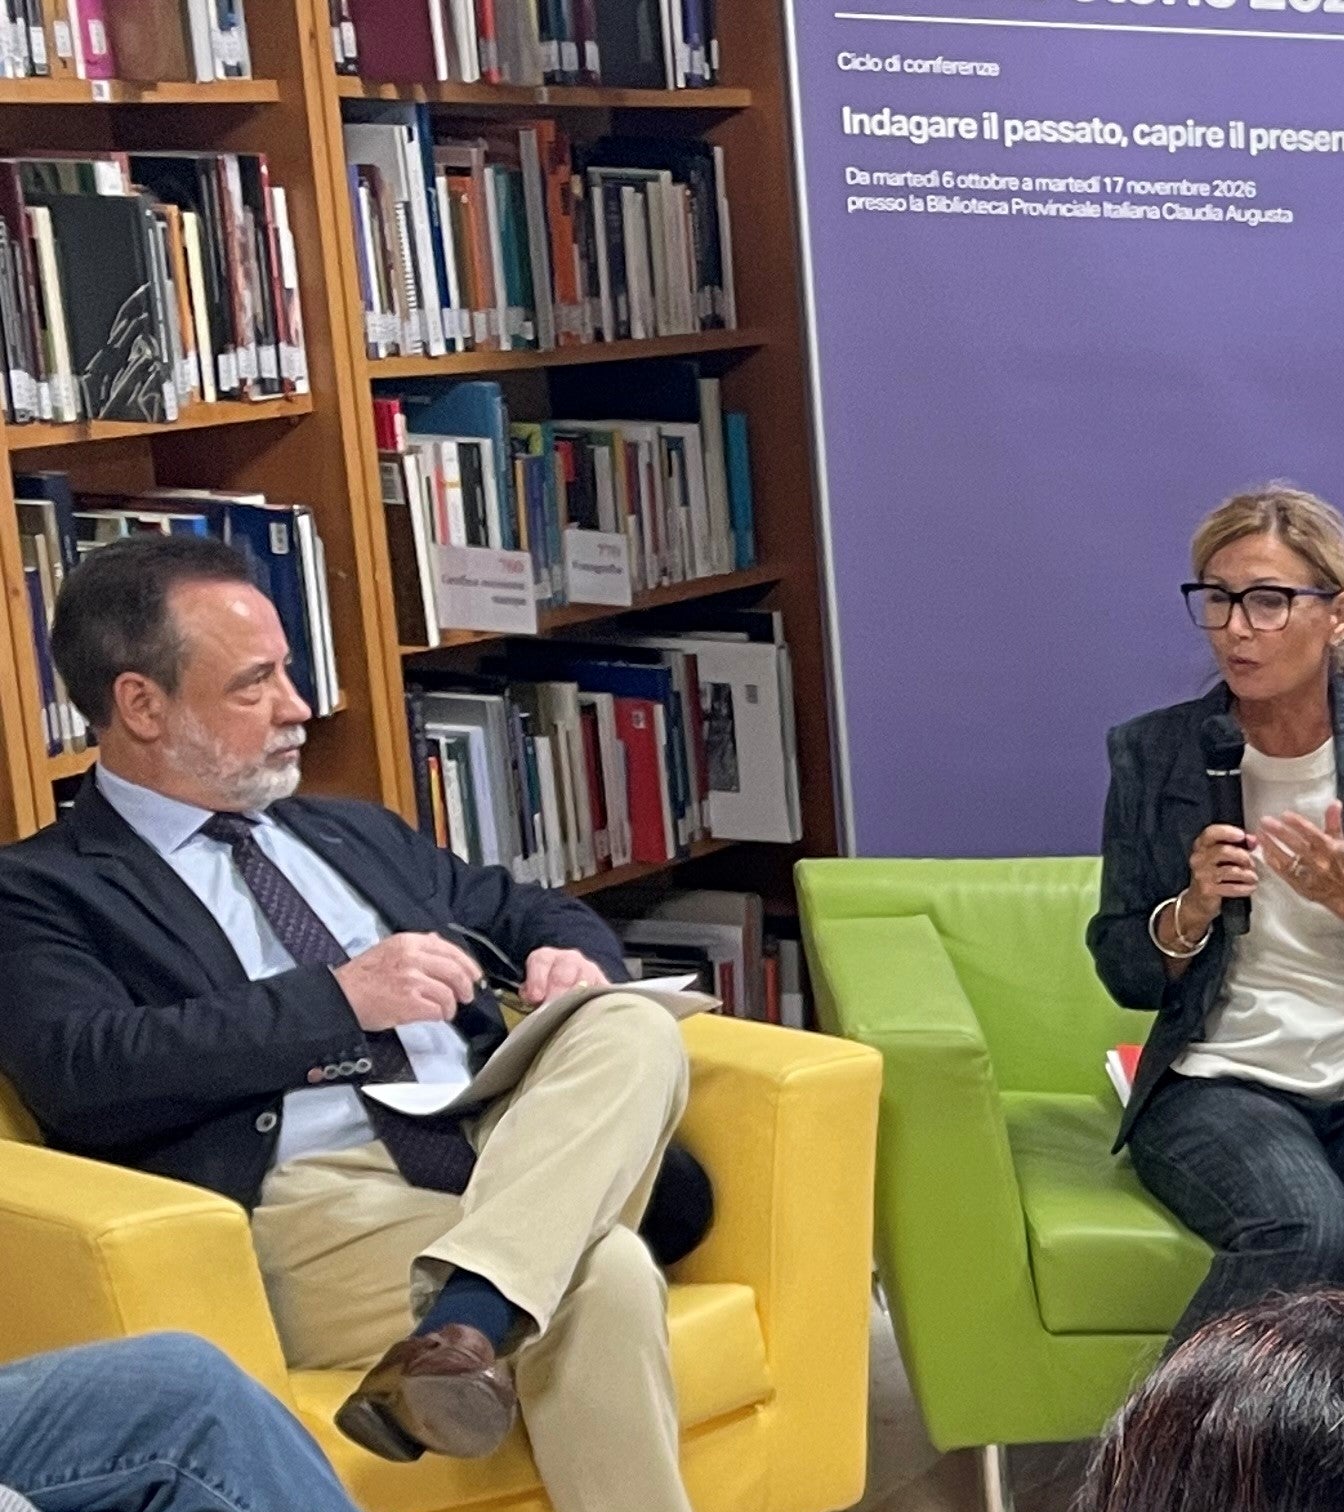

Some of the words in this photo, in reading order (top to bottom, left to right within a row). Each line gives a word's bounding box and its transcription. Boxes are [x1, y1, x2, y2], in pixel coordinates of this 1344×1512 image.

[837, 52, 882, 73] Ciclo
[884, 54, 900, 73] di
[904, 56, 999, 77] conferenze
[842, 107, 977, 147] Indagare
[982, 109, 999, 140] il
[1004, 113, 1128, 149] passato,
[1133, 119, 1223, 152] capire
[1229, 119, 1245, 149] il
[846, 167, 871, 186] Da
[943, 171, 953, 188] 6
[956, 172, 1018, 191] ottobre
[1022, 178, 1033, 191] a
[1103, 177, 1124, 195] 17
[1127, 177, 1210, 197] novembre
[1213, 179, 1256, 198] 2026
[848, 196, 907, 214] presso
[910, 194, 924, 212] la
[927, 195, 1008, 217] Biblioteca
[1011, 198, 1100, 219] Provinciale
[1104, 201, 1159, 220] Italiana
[1163, 202, 1222, 221] Claudia
[1226, 204, 1293, 225] Augusta
